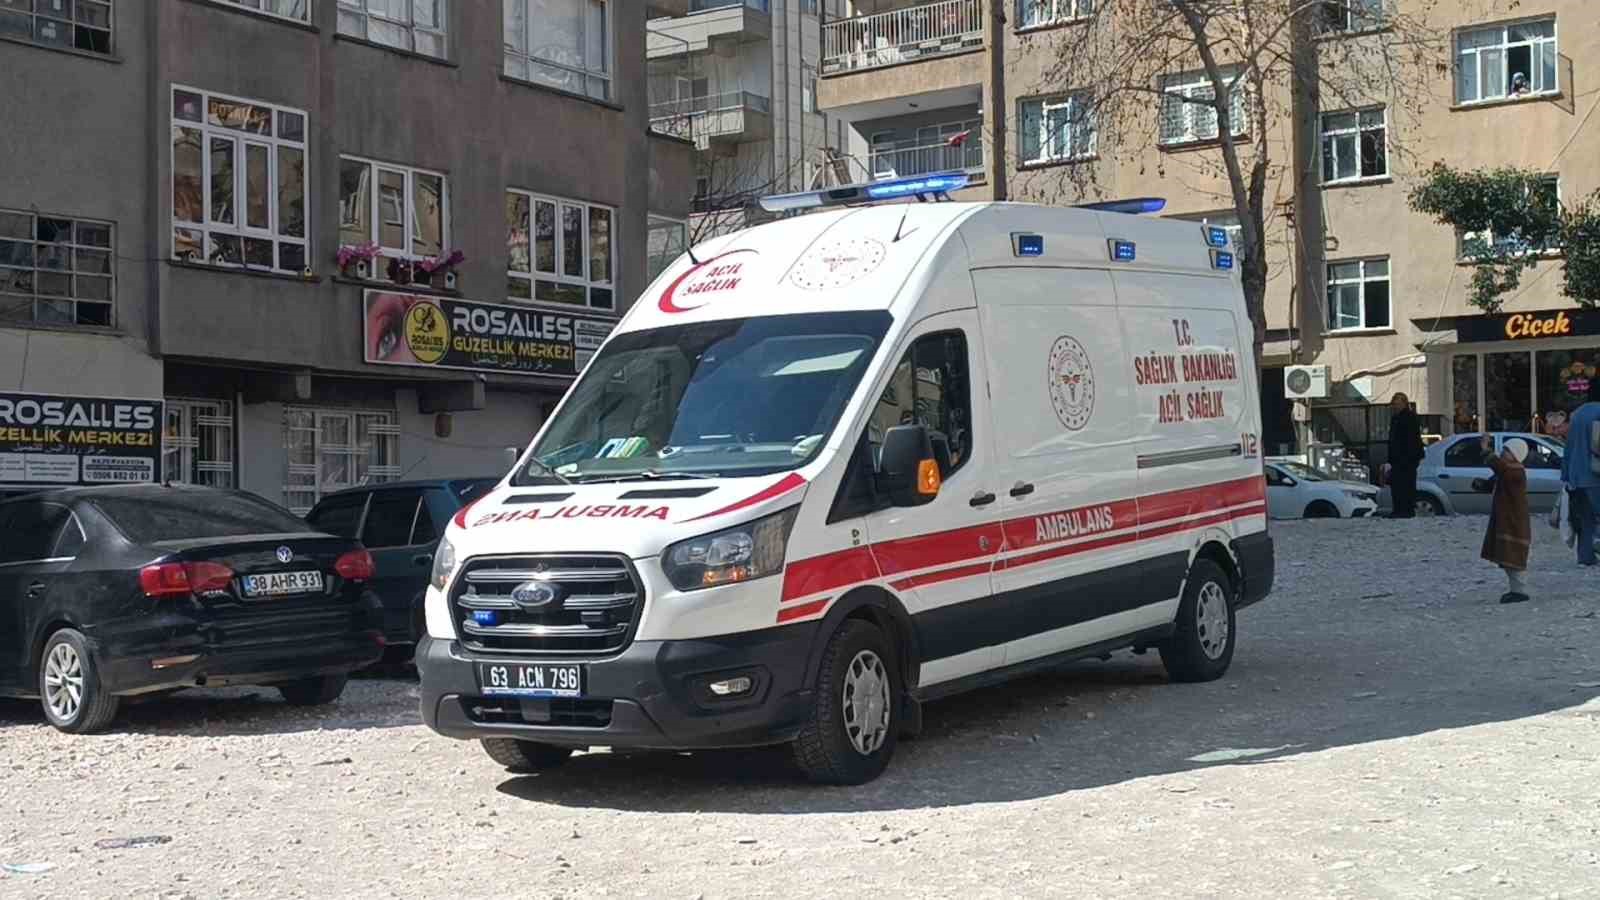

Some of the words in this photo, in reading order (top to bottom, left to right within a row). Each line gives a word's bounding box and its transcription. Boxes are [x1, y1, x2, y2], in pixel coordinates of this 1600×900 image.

[453, 307, 572, 341] ROSALLES
[1172, 319, 1194, 346] T.C.
[1135, 351, 1178, 385] SAĞLIK
[1182, 348, 1237, 382] BAKANLIĞI
[0, 400, 154, 429] ROSALLES
[68, 430, 153, 447] MERKEZİ
[1241, 432, 1257, 459] 112
[1035, 506, 1114, 541] AMBULANS
[252, 576, 267, 591] 38
[270, 574, 297, 588] AHR
[301, 572, 321, 587] 931
[490, 666, 508, 686] 63
[519, 666, 544, 688] ACN
[550, 667, 577, 688] 796
